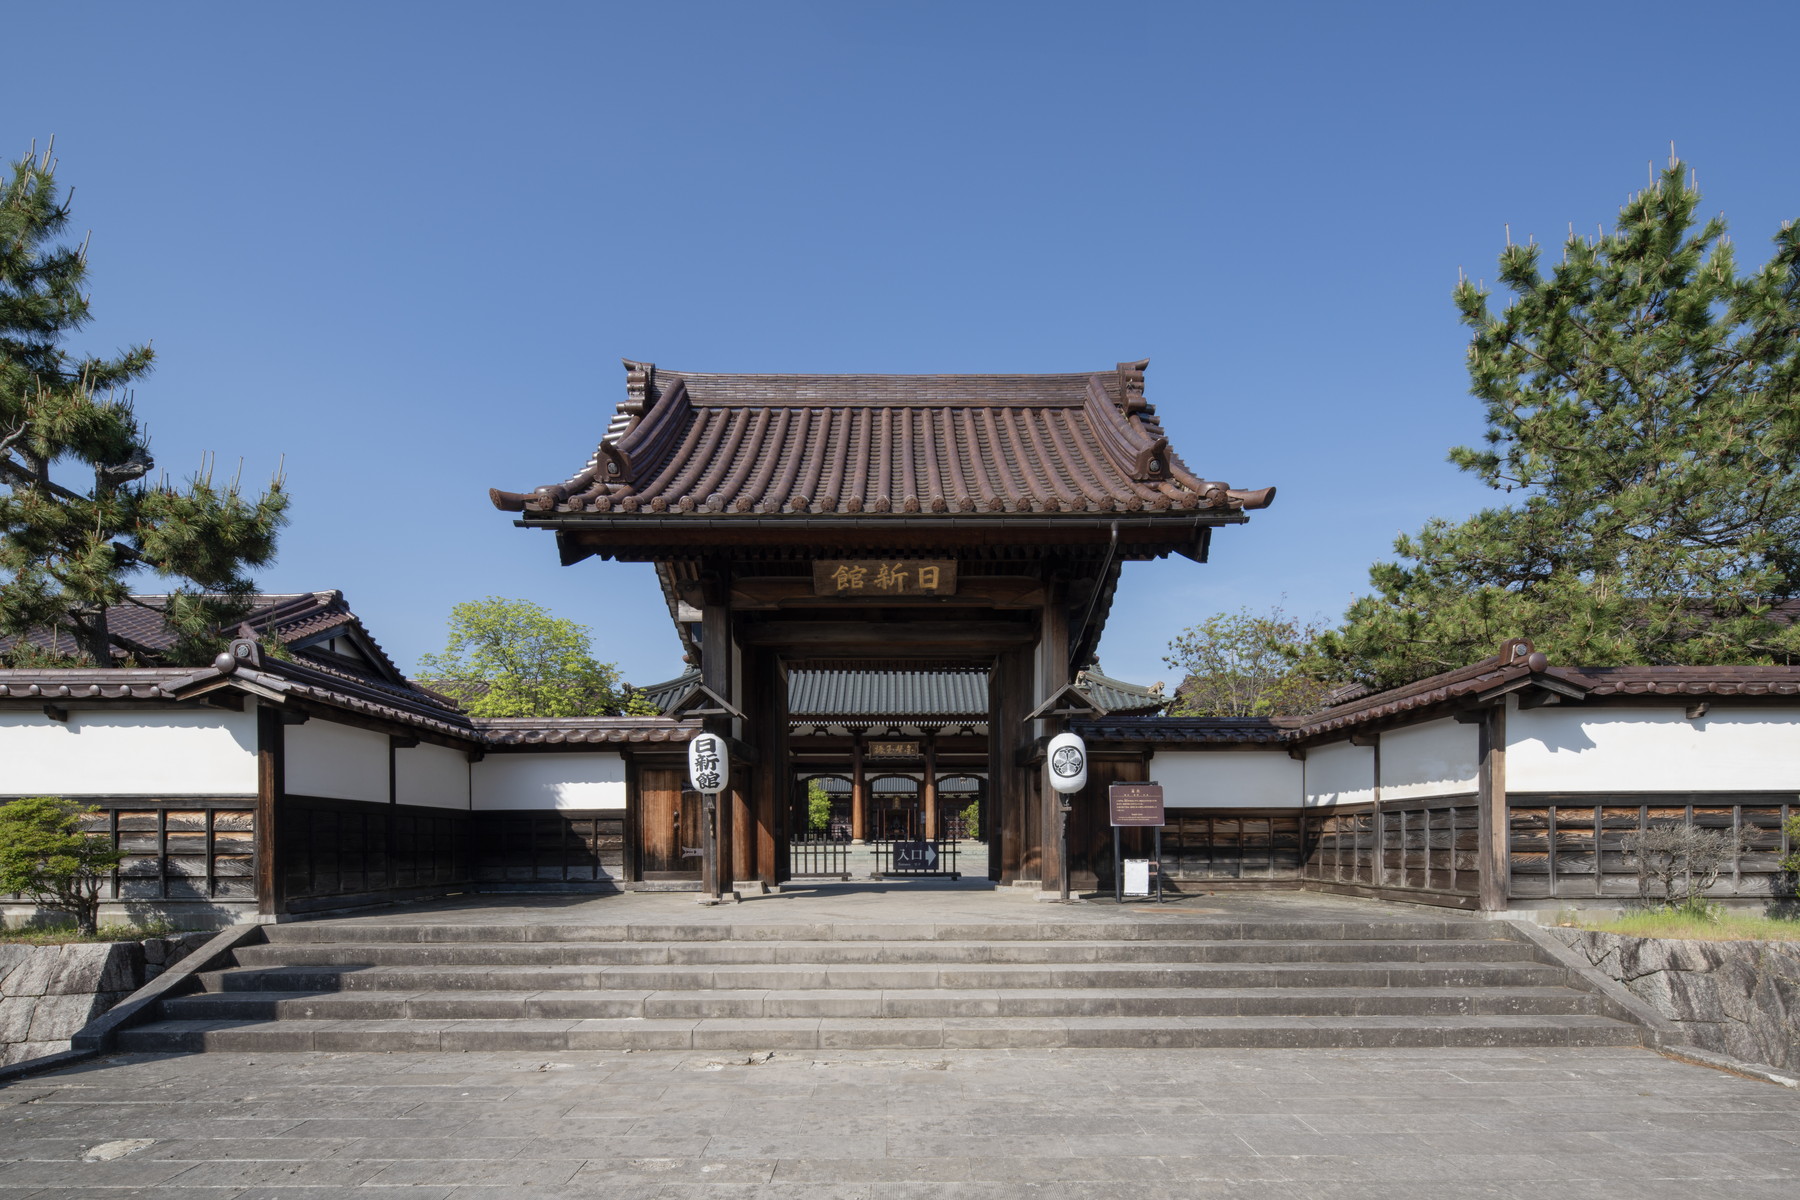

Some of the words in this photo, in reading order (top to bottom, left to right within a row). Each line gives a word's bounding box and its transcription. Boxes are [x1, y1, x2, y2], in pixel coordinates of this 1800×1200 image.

[695, 738, 720, 789] 日新館
[897, 848, 922, 861] 入口
